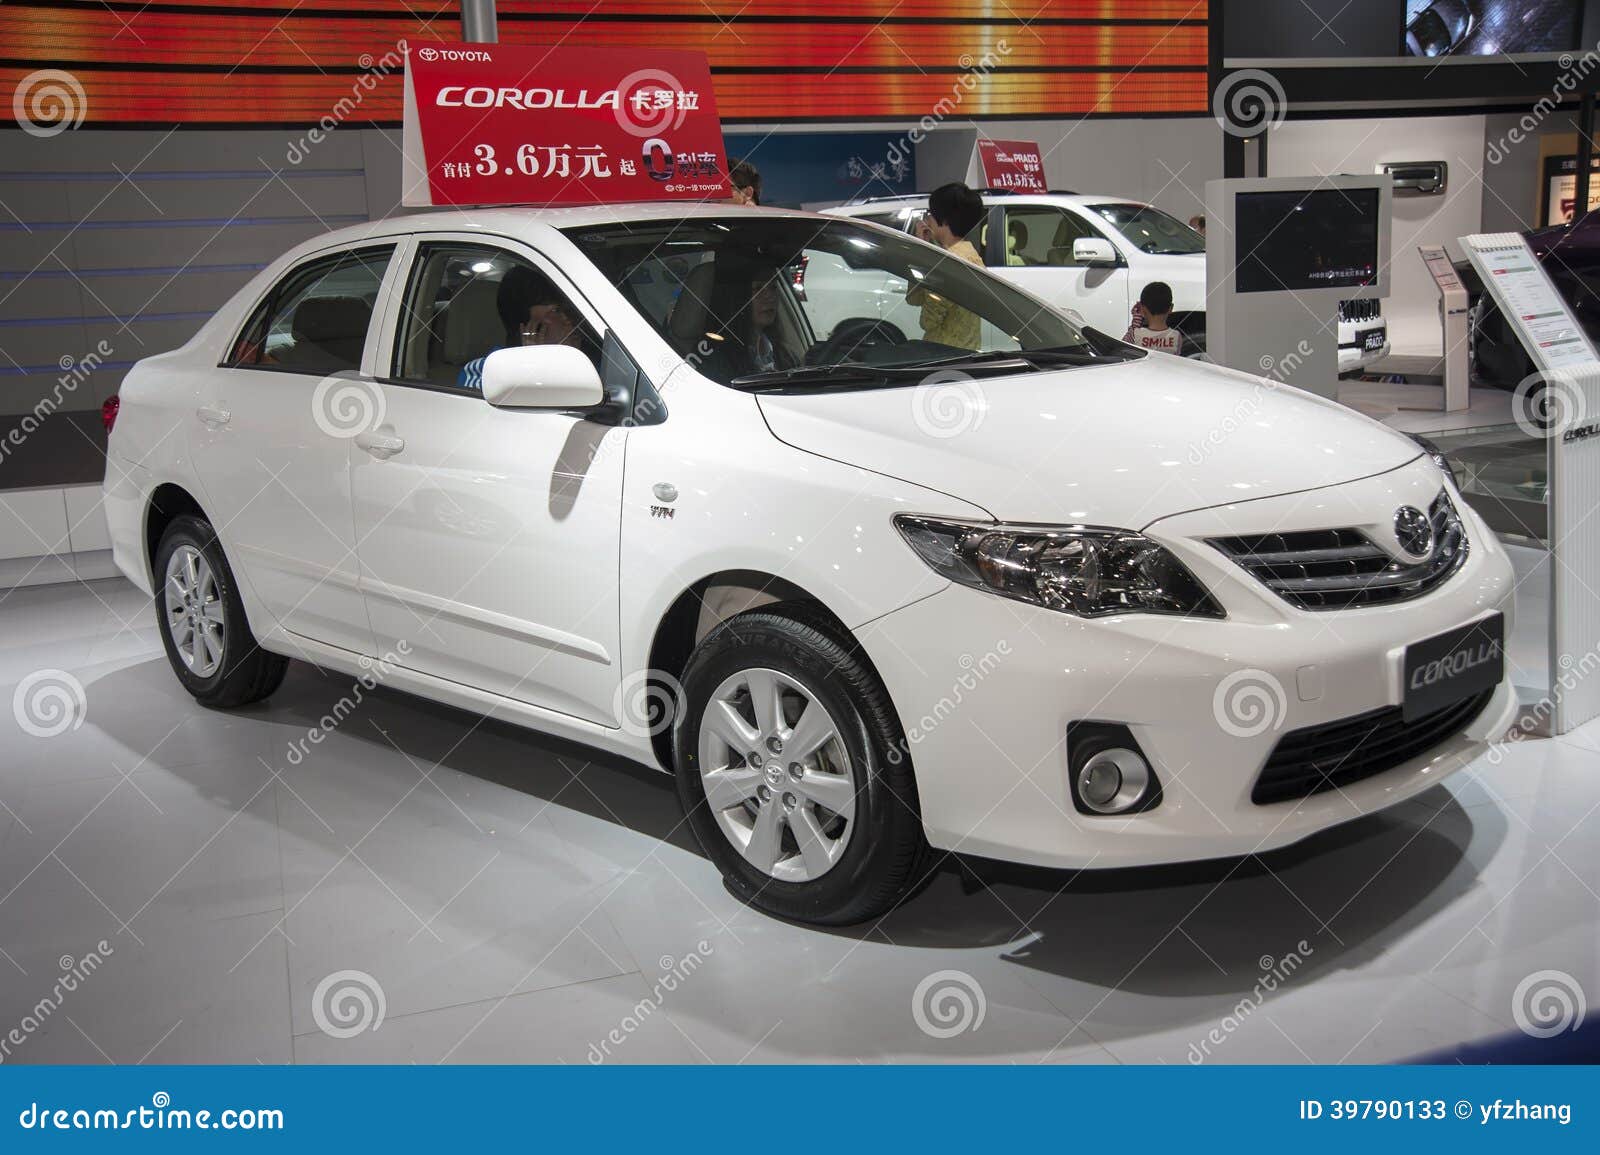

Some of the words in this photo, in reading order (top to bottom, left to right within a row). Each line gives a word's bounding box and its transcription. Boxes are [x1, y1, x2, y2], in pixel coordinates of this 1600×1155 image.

[440, 50, 492, 62] TOYOTA
[436, 86, 619, 110] COROLLA
[629, 90, 699, 110] 卡罗拉
[1013, 153, 1038, 163] PRADO
[1142, 336, 1174, 347] SMILE
[1410, 638, 1499, 690] COROLLA
